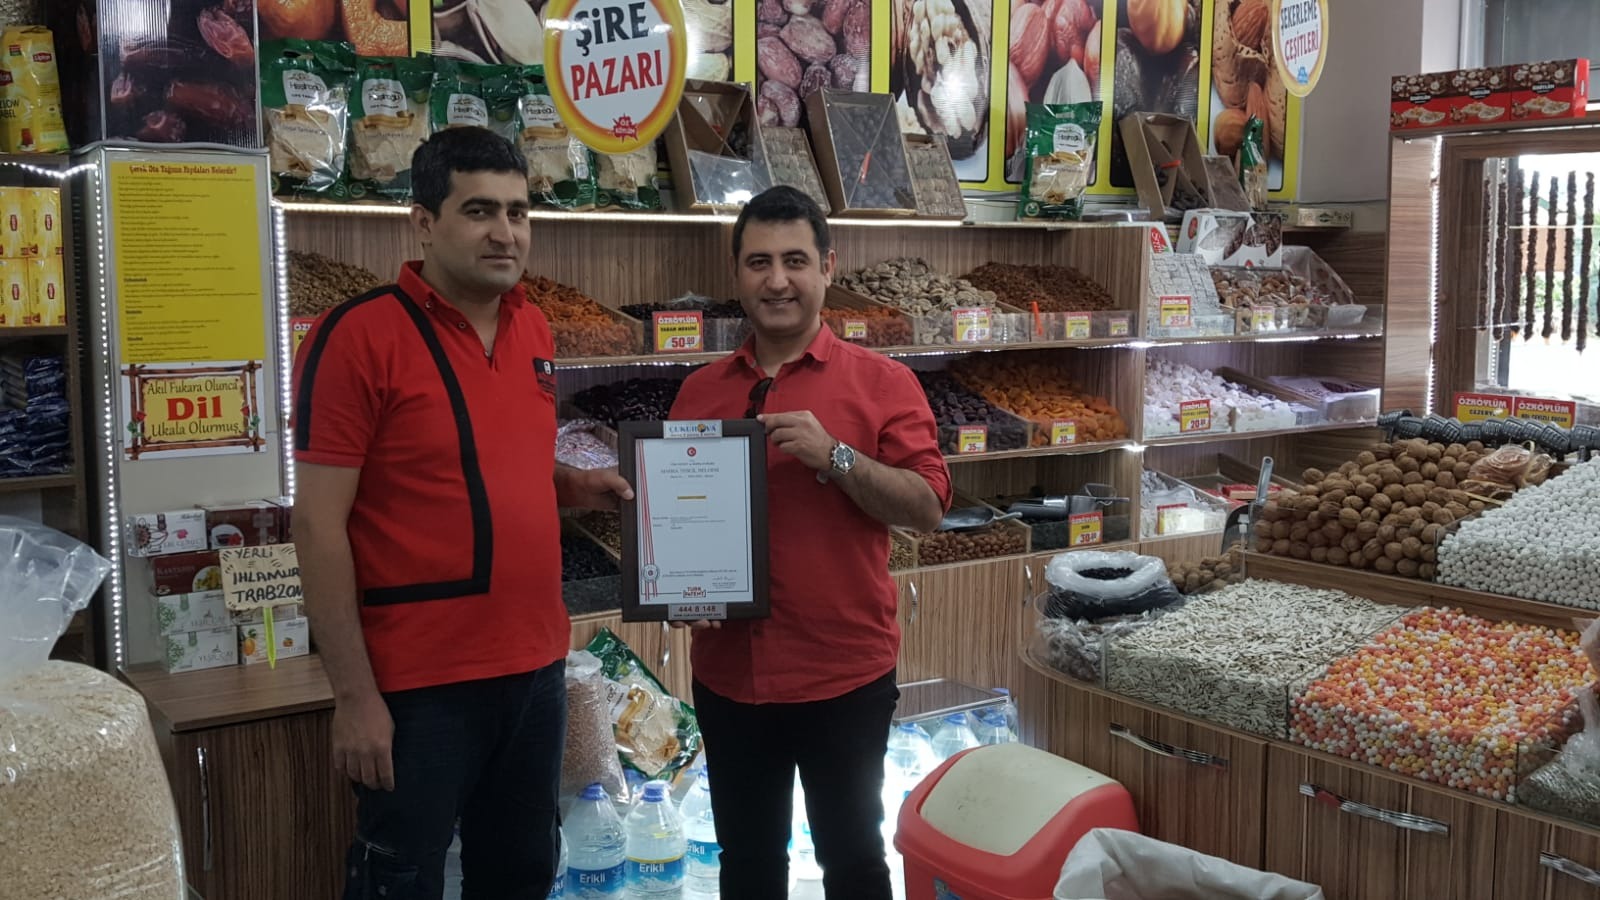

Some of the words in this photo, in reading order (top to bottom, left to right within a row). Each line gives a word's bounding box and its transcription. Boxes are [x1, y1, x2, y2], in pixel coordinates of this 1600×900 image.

[571, 50, 663, 101] PAZARI
[671, 337, 685, 348] 50
[147, 383, 167, 395] Akıl
[169, 382, 202, 394] Fukara
[205, 379, 238, 391] Olunca
[166, 395, 222, 421] Dil
[1458, 396, 1507, 408] ÖZKÖYLÜM
[1518, 402, 1569, 413] ÖZKÖYLÜM
[1469, 409, 1496, 417] CEZERY
[151, 422, 185, 437] Ukala
[189, 421, 239, 435] Olurmuş
[232, 567, 300, 585] IHLAMUR
[639, 863, 664, 873] Erikli
[579, 873, 606, 883] Erikli
